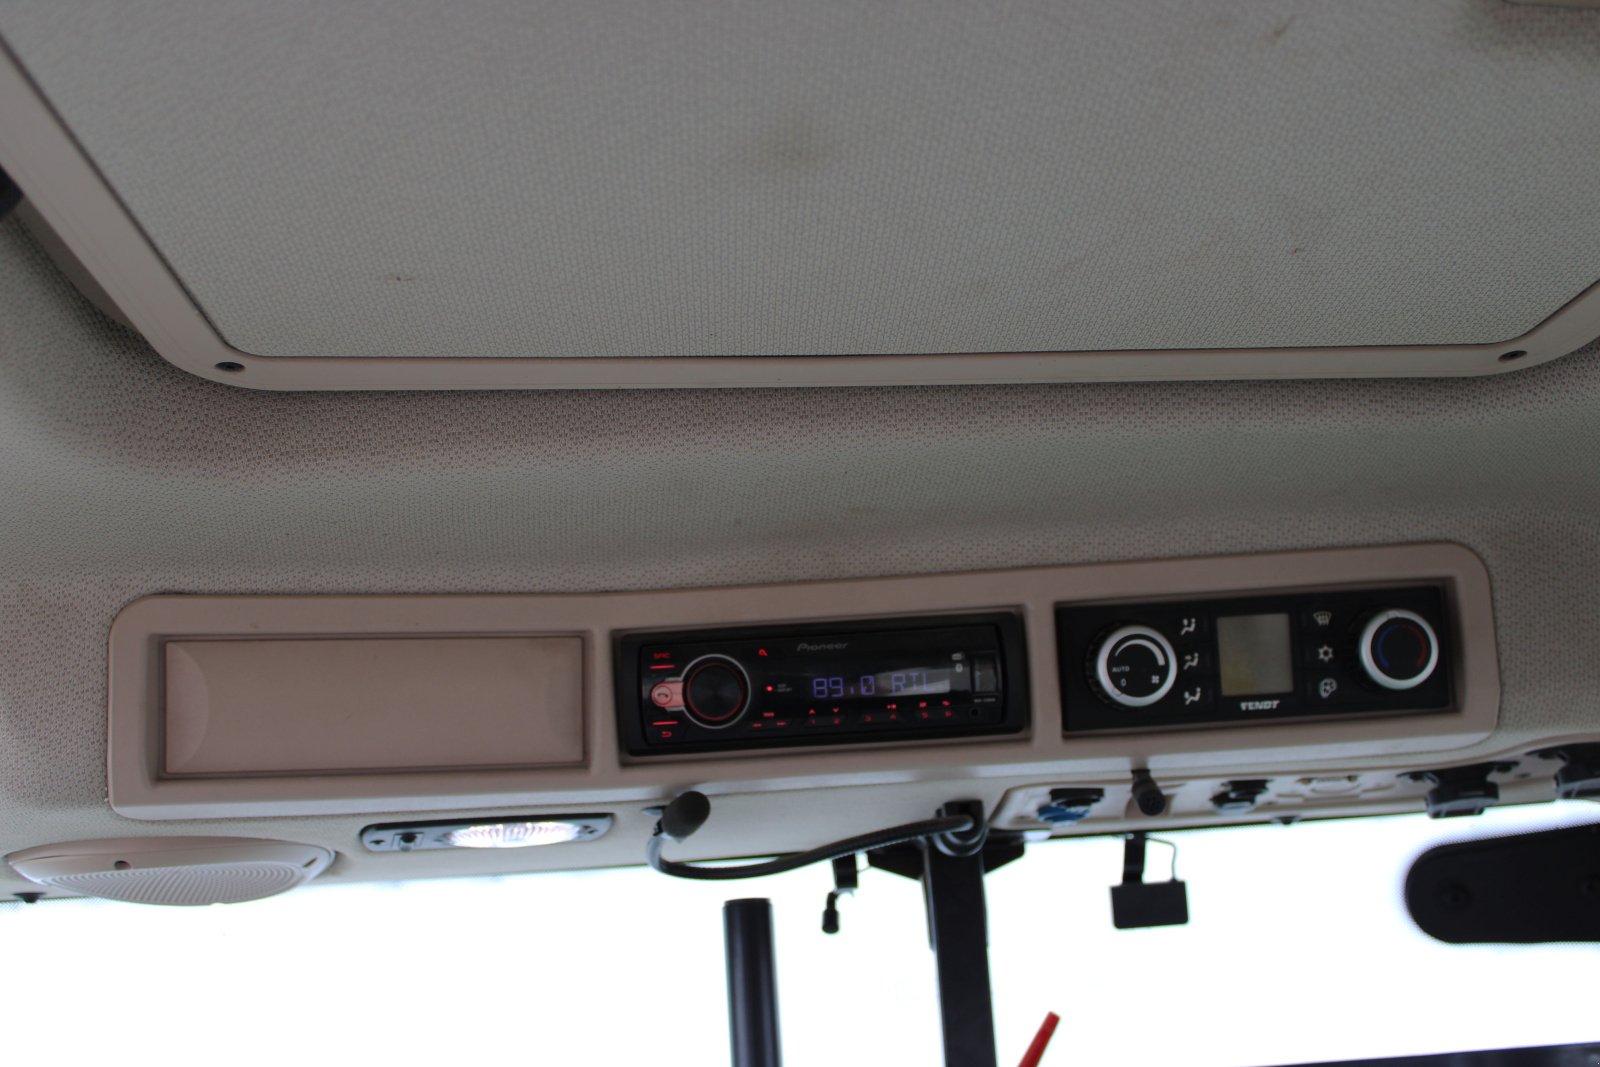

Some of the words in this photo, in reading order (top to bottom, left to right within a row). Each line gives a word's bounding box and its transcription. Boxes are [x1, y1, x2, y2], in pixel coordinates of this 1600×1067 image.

[797, 642, 848, 652] Pioneer
[1112, 665, 1130, 673] AUTO
[1240, 700, 1280, 711] FENDT
